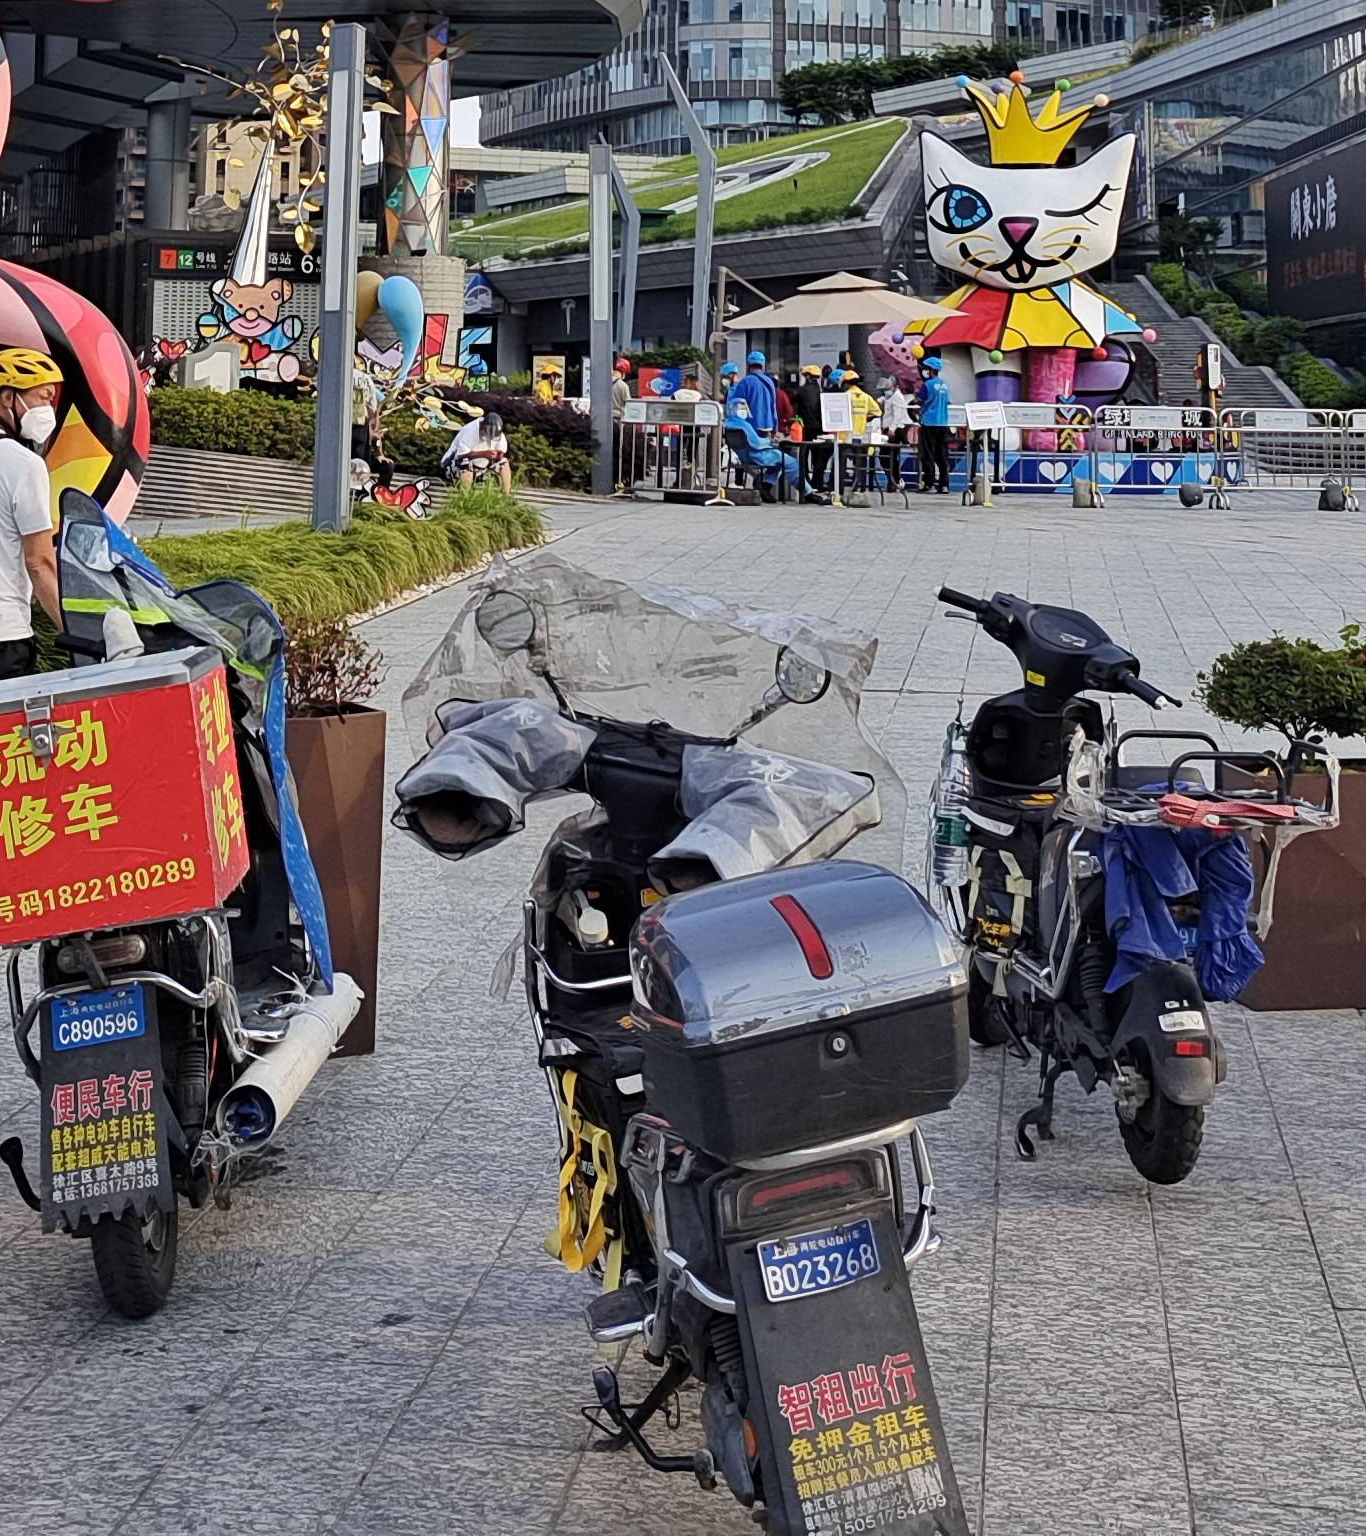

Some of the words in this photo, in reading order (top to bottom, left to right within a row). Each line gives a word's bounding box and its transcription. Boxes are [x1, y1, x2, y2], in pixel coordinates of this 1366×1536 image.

[179, 254, 193, 266] 12
[300, 255, 314, 273] 6
[58, 1010, 139, 1045] C890596
[51, 1069, 154, 1126] 便民车行
[51, 1112, 156, 1152] 售各种电动车自行车
[51, 1137, 157, 1173] 配套超威天能电池
[766, 1243, 875, 1296] B023268
[778, 1352, 916, 1435] 智租出行
[788, 1404, 928, 1464] 免押金租车
